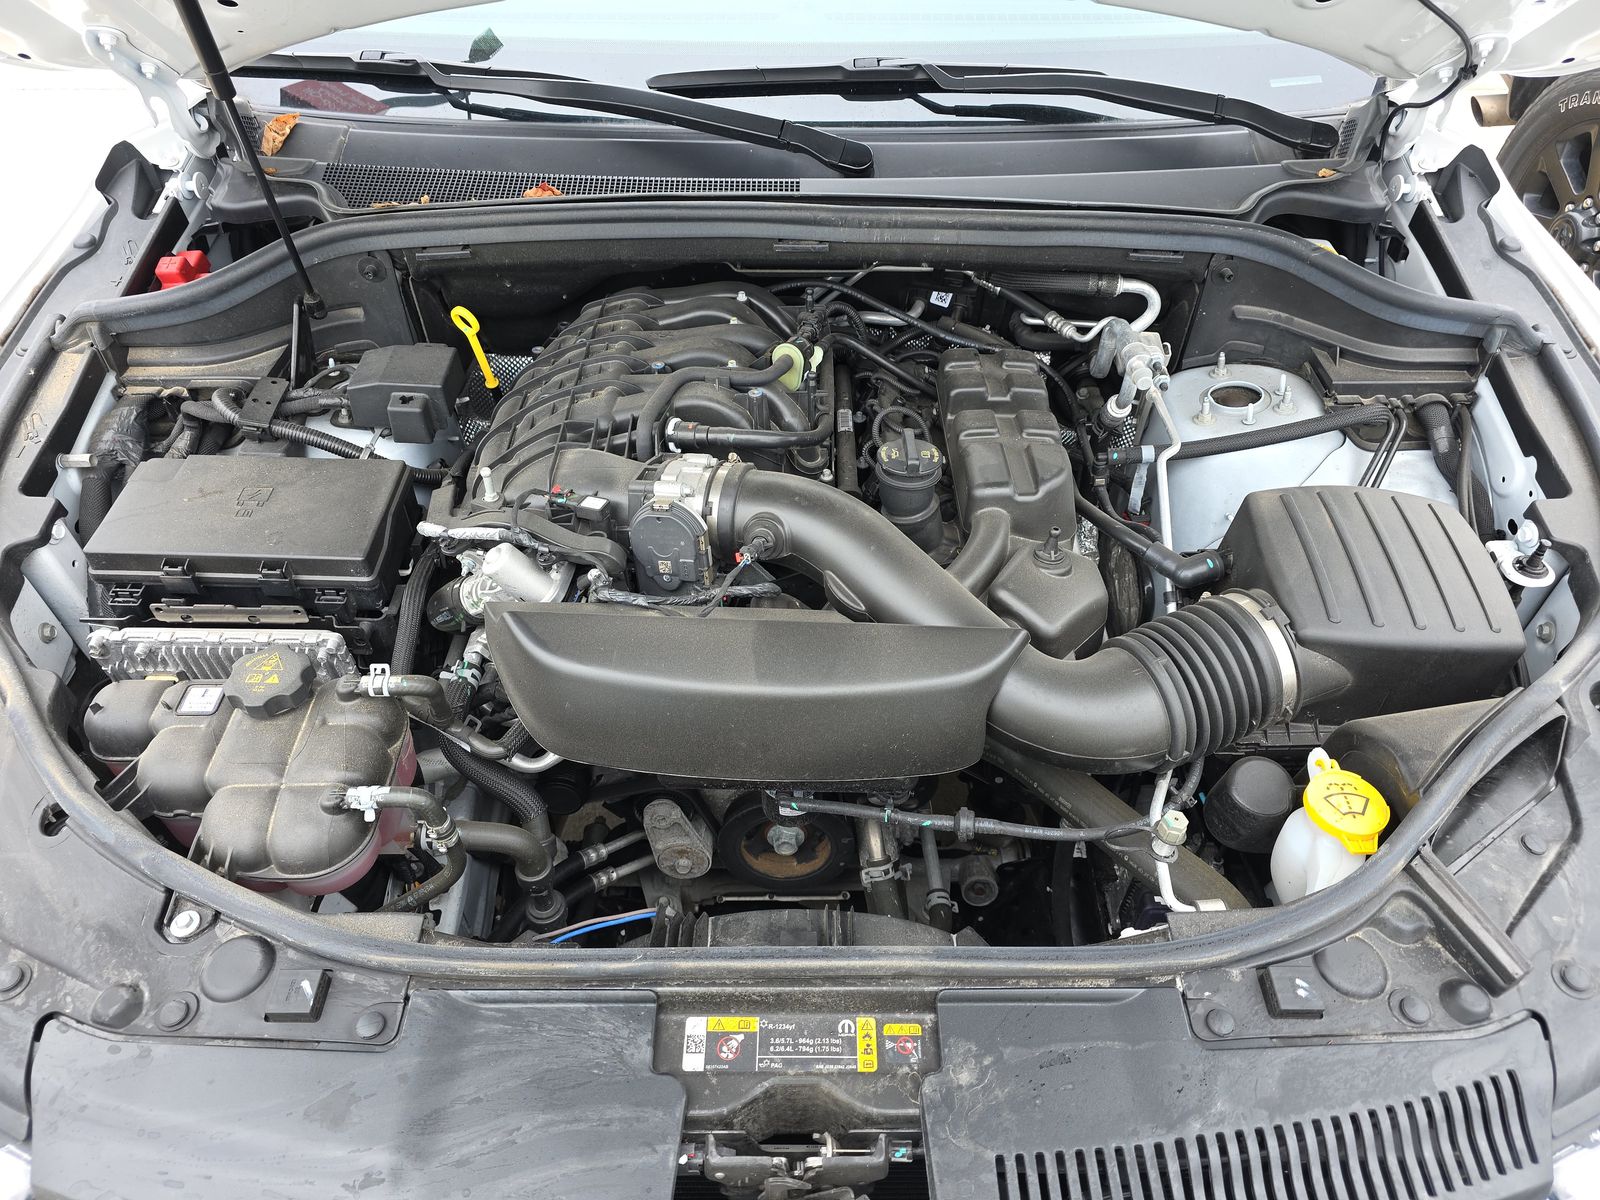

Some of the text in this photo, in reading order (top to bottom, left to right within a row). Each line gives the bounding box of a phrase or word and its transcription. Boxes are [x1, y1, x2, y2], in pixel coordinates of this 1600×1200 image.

[768, 1023, 796, 1031] R-1234yf
[815, 1037, 830, 1045] (2.13
[830, 1037, 843, 1045] lbs)
[798, 1045, 814, 1053] 794g
[815, 1045, 830, 1053] (1.75
[830, 1045, 843, 1053] lbs)
